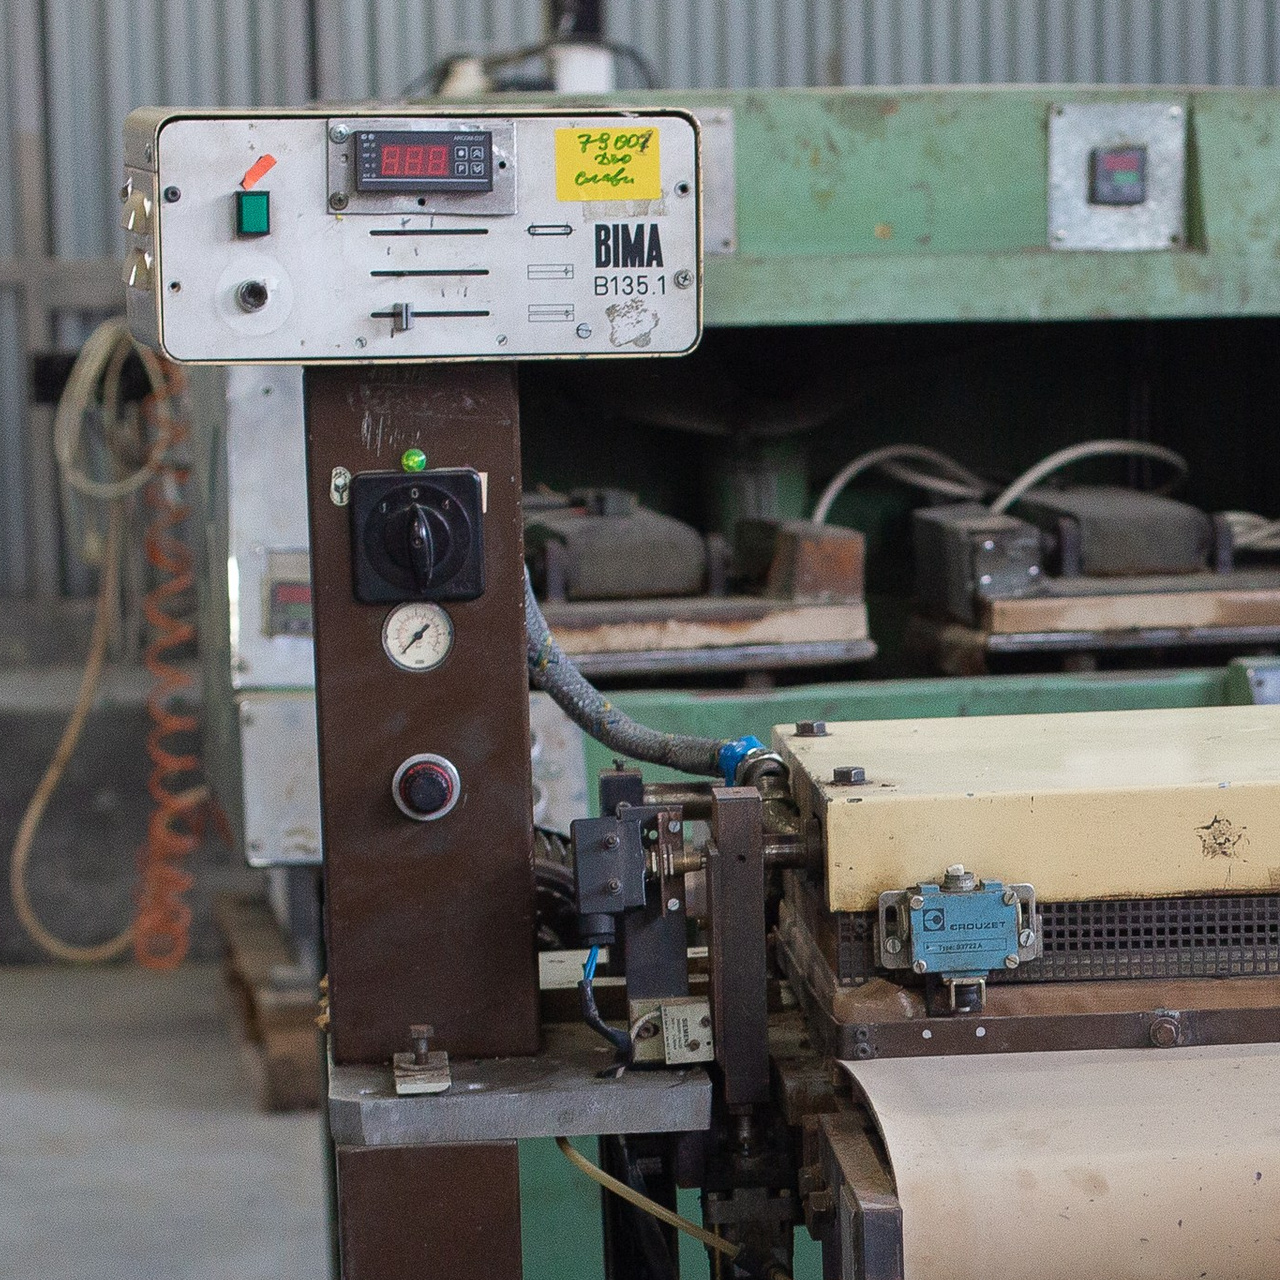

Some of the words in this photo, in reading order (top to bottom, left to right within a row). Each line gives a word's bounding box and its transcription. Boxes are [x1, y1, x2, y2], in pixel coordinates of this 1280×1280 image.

[594, 223, 665, 268] BIMA
[594, 274, 666, 296] B135.1
[411, 487, 419, 499] 0
[949, 921, 1006, 931] CROUZET
